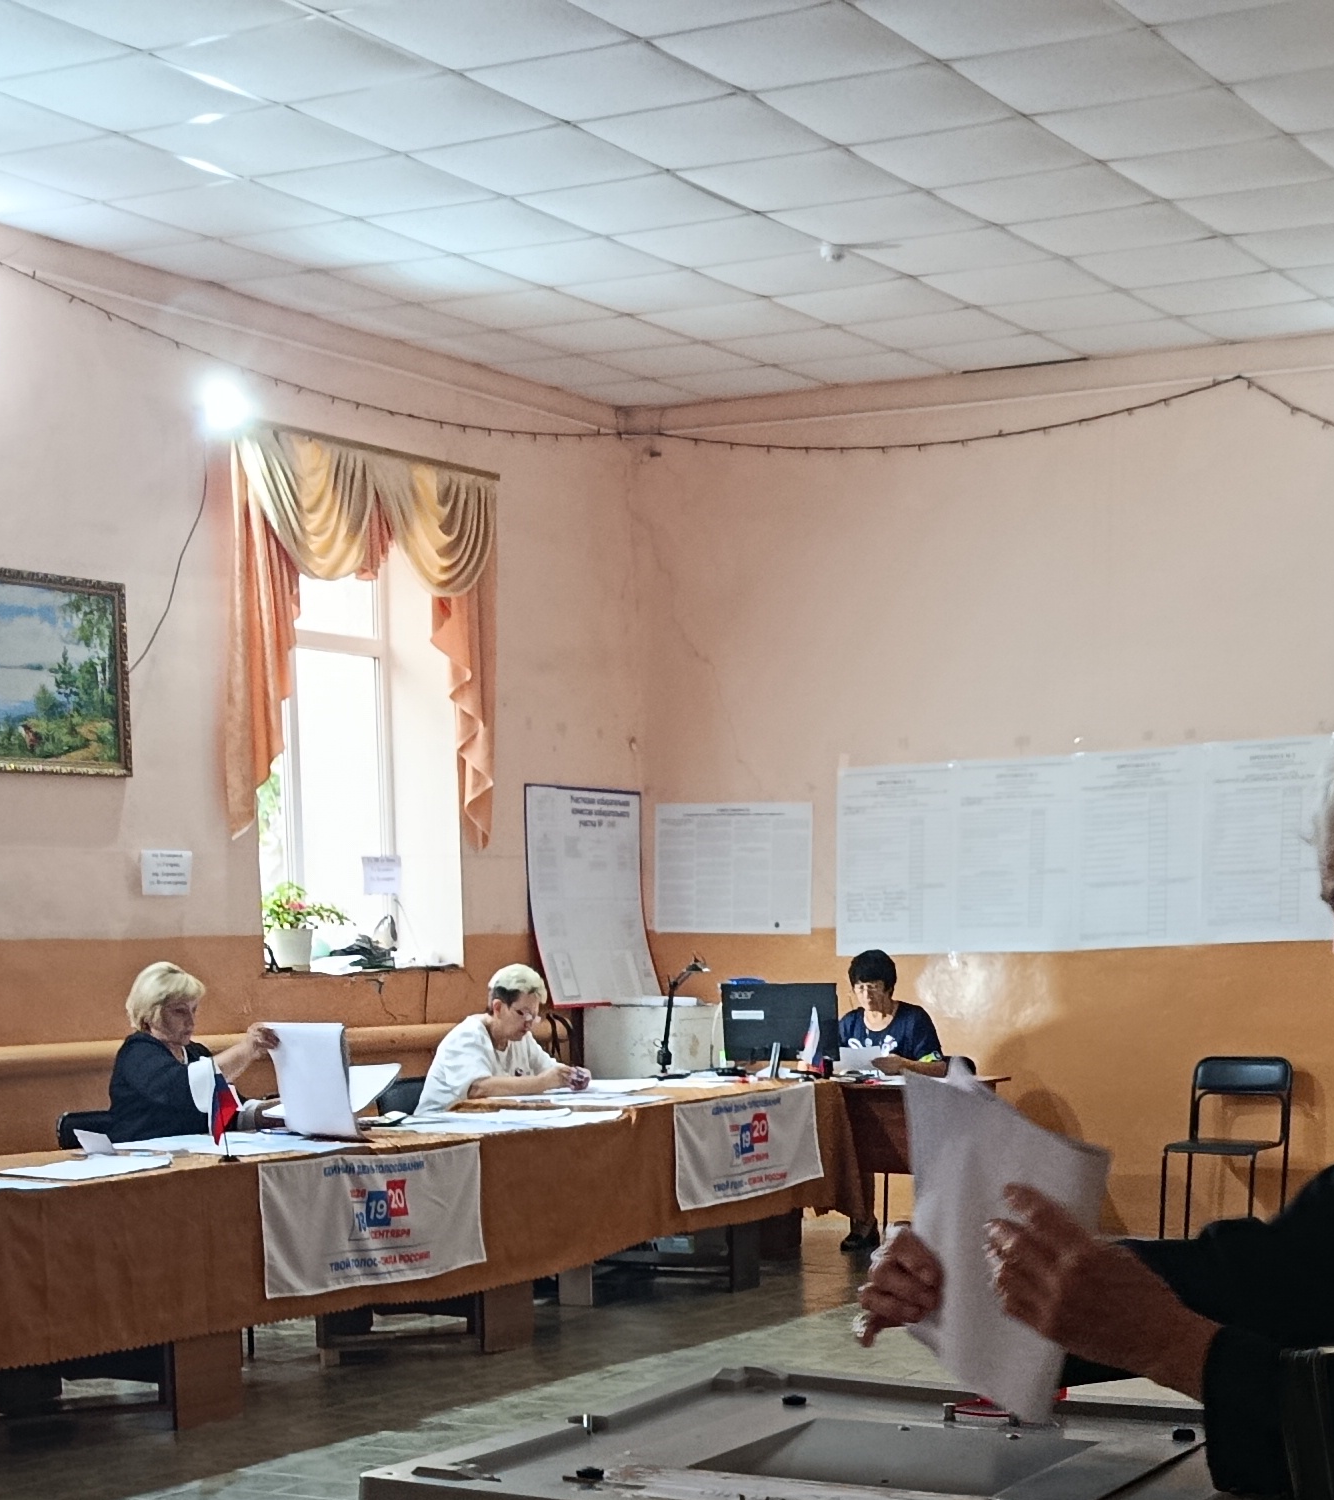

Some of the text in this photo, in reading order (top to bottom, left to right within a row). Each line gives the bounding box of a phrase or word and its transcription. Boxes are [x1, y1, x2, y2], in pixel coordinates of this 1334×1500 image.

[729, 990, 755, 1000] acer
[753, 1119, 767, 1137] 20
[742, 1130, 751, 1148] 19
[388, 1188, 405, 1209] 20
[369, 1200, 387, 1220] 19
